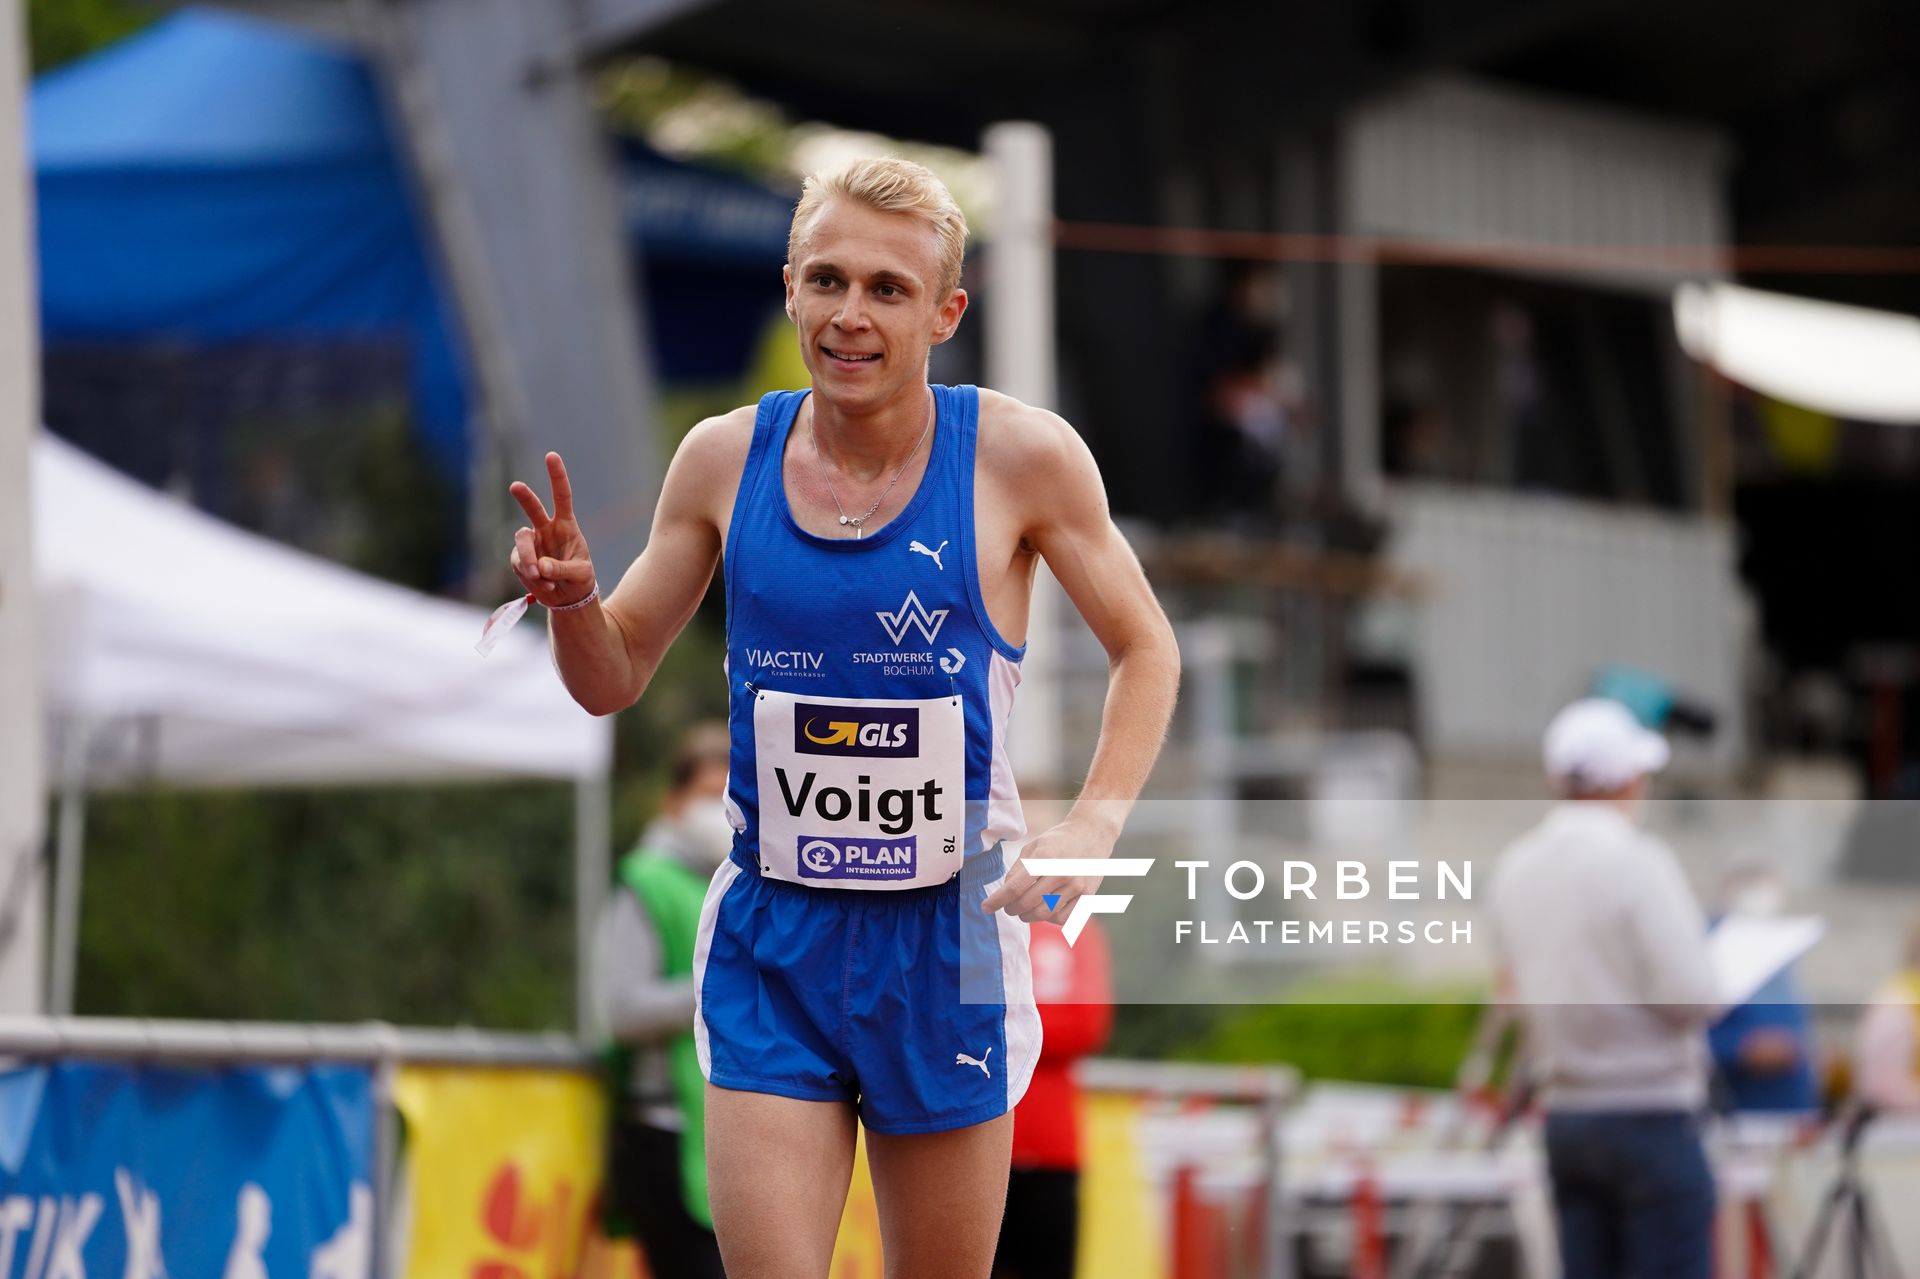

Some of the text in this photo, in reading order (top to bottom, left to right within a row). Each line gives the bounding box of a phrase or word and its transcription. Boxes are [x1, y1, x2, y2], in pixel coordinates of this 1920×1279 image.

[745, 648, 824, 670] VIACTIV
[852, 652, 933, 664] STADTWERKE
[770, 670, 827, 679] Krankenkasse
[883, 665, 935, 676] BOCHUM
[858, 722, 908, 748] GLS
[774, 767, 943, 835] Voigt
[942, 835, 956, 854] 78
[845, 846, 912, 865] PLAN
[845, 867, 912, 875] INTERNATIONAL
